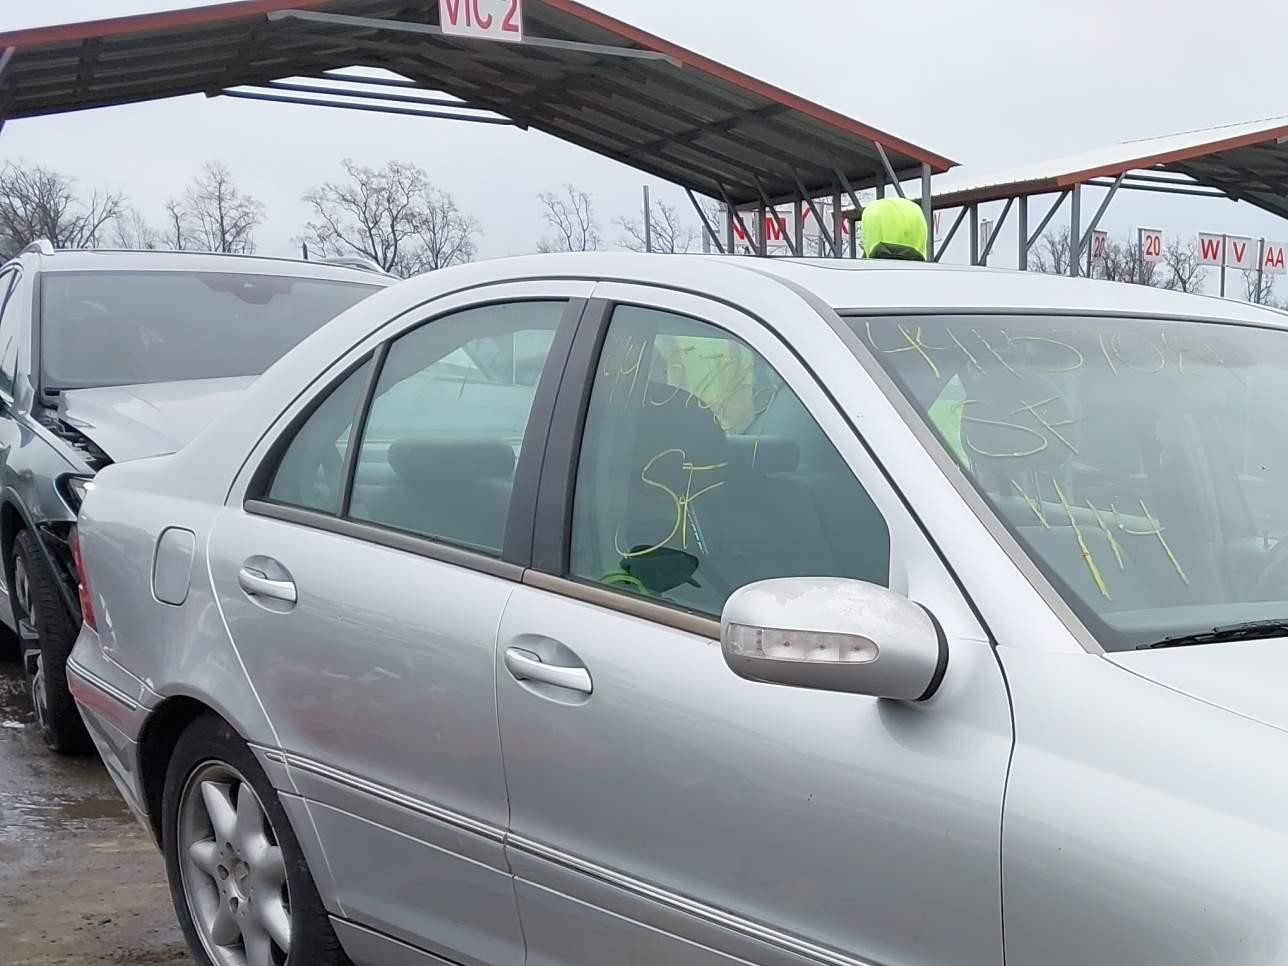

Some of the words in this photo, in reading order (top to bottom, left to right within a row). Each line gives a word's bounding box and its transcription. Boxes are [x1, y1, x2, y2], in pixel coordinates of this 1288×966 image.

[1145, 235, 1161, 256] 20
[1201, 239, 1220, 260] W
[1233, 242, 1246, 263] V
[1265, 247, 1285, 268] AA
